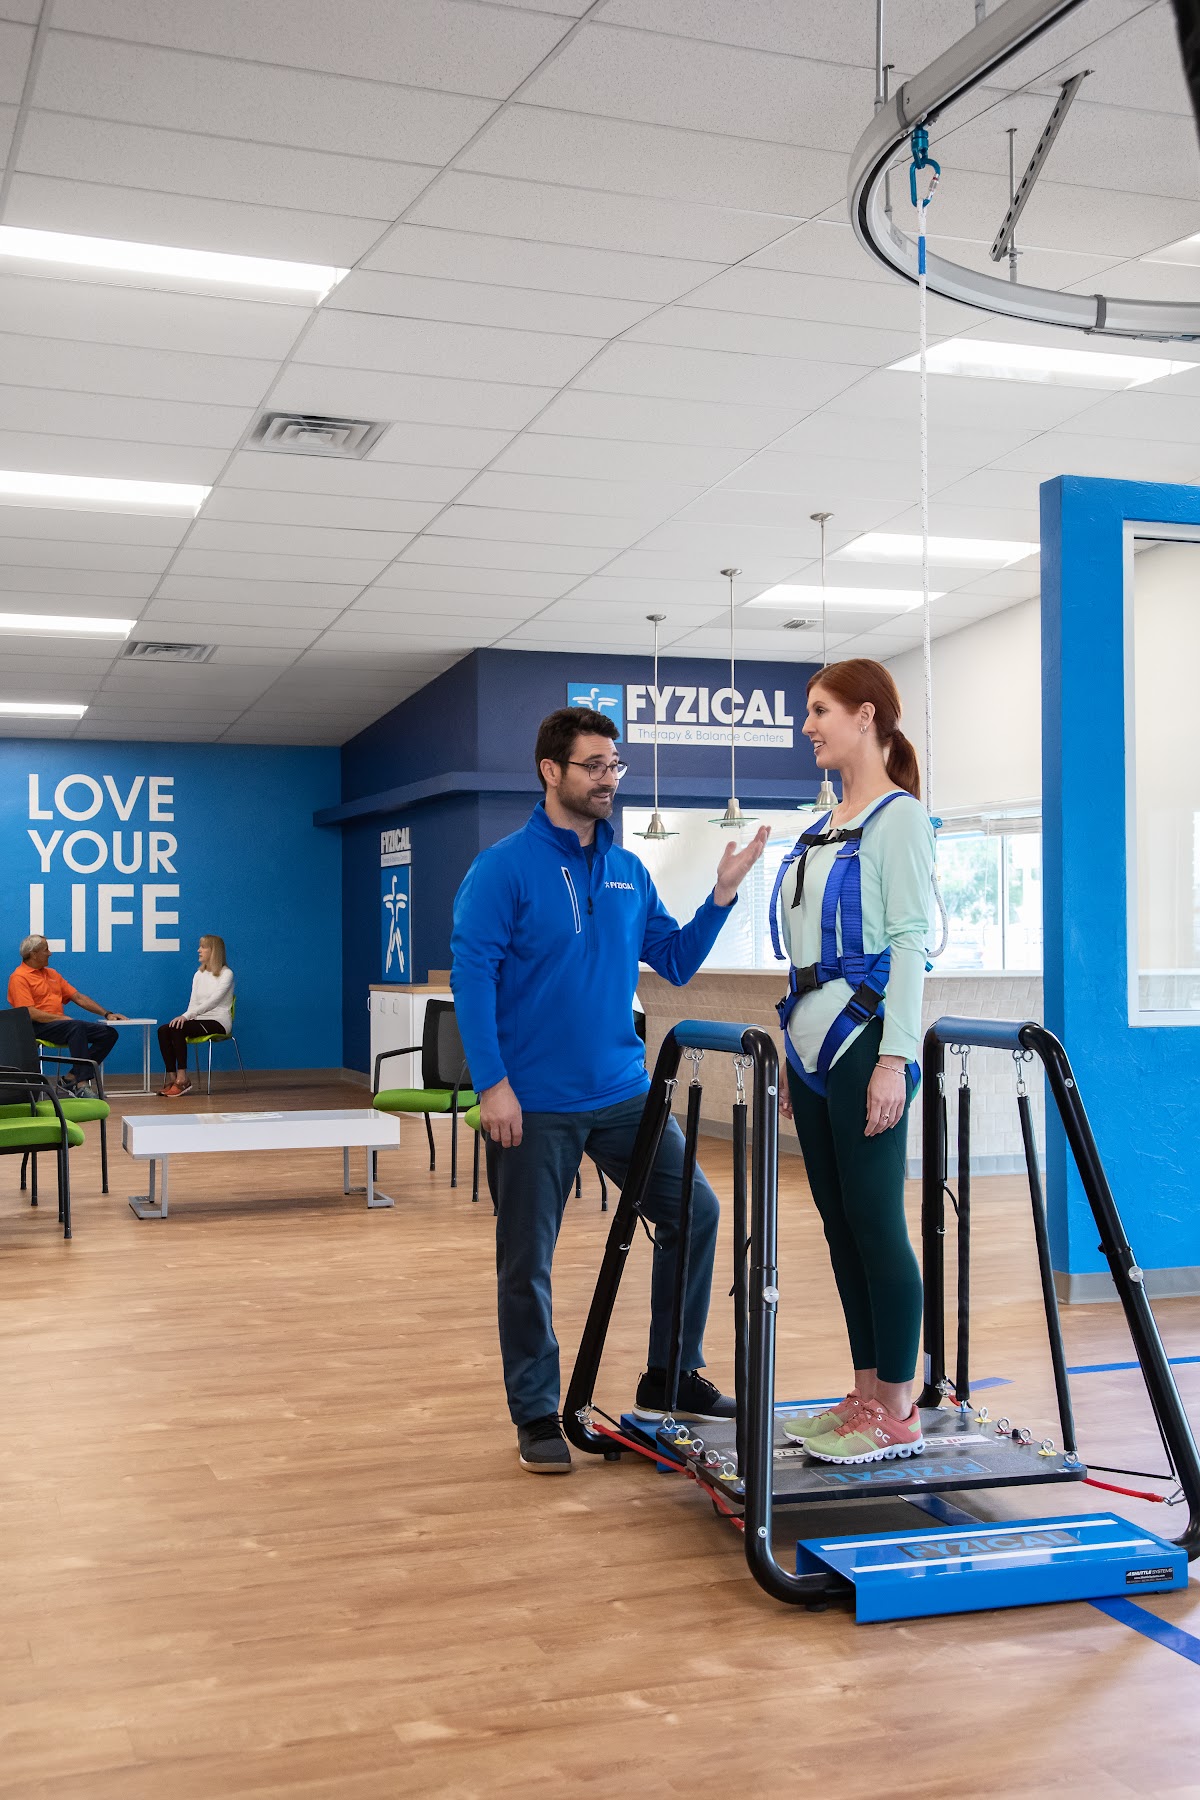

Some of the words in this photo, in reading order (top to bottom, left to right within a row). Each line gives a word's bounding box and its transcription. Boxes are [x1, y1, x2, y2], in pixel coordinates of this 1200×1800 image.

[626, 684, 794, 726] FYZICAL
[637, 728, 682, 742] Therapy
[685, 729, 693, 740] &
[696, 730, 740, 741] Balance
[743, 731, 784, 743] Centers
[28, 773, 175, 822] LOVE
[27, 829, 178, 874] YOUR
[381, 827, 411, 854] FYZICAL
[29, 883, 180, 952] LIFE
[824, 1463, 983, 1483] FYZICAL
[904, 1533, 1074, 1558] FYZICAL
